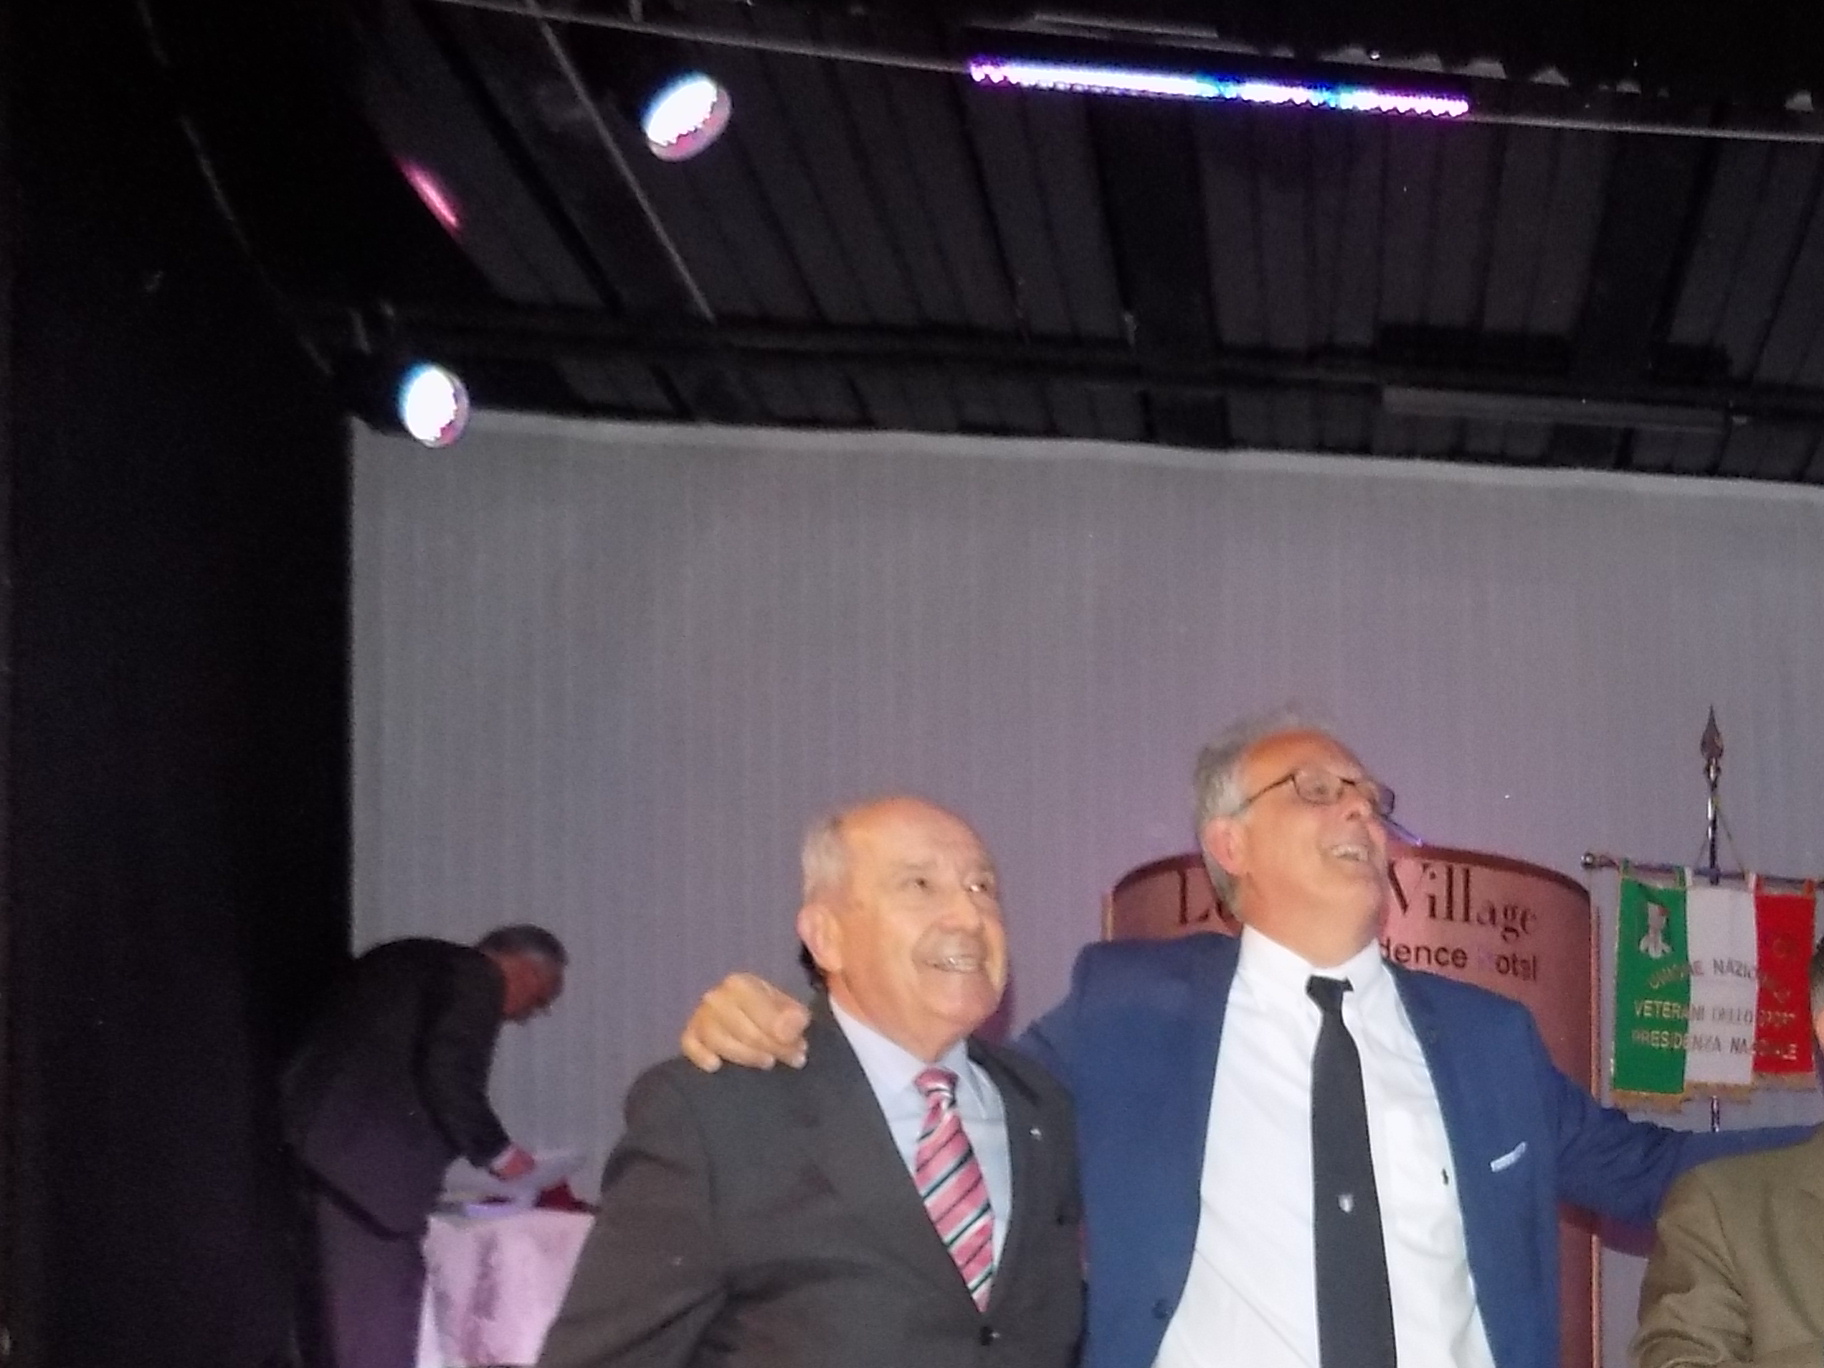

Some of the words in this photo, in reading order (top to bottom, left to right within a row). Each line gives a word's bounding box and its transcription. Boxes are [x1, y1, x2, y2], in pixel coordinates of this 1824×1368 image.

[1386, 858, 1538, 942] Village
[1634, 999, 1705, 1021] VETERANI
[1631, 1030, 1721, 1052] PRESIDENZA
